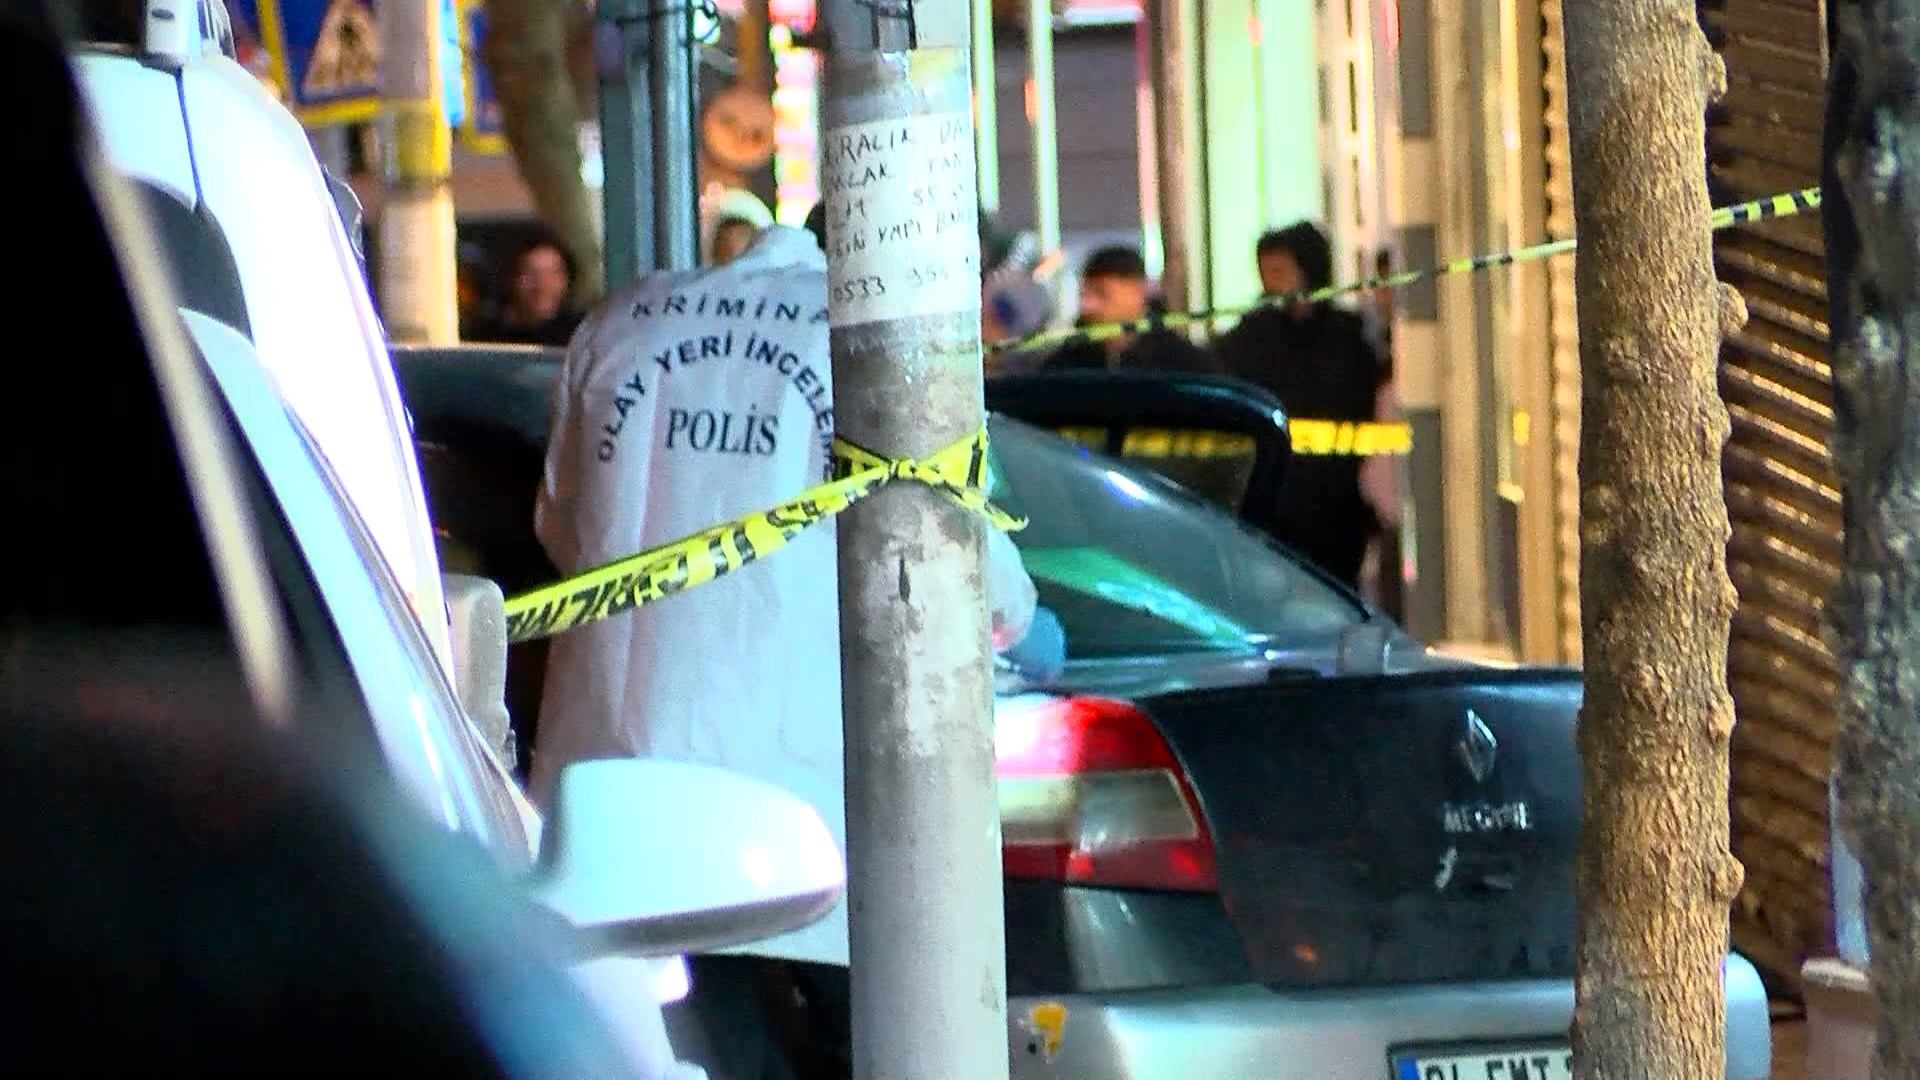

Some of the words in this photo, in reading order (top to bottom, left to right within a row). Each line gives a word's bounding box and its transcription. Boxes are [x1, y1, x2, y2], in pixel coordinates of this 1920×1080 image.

[597, 369, 646, 464] OLAY
[654, 328, 733, 374] YERİ
[665, 402, 779, 456] POLİS
